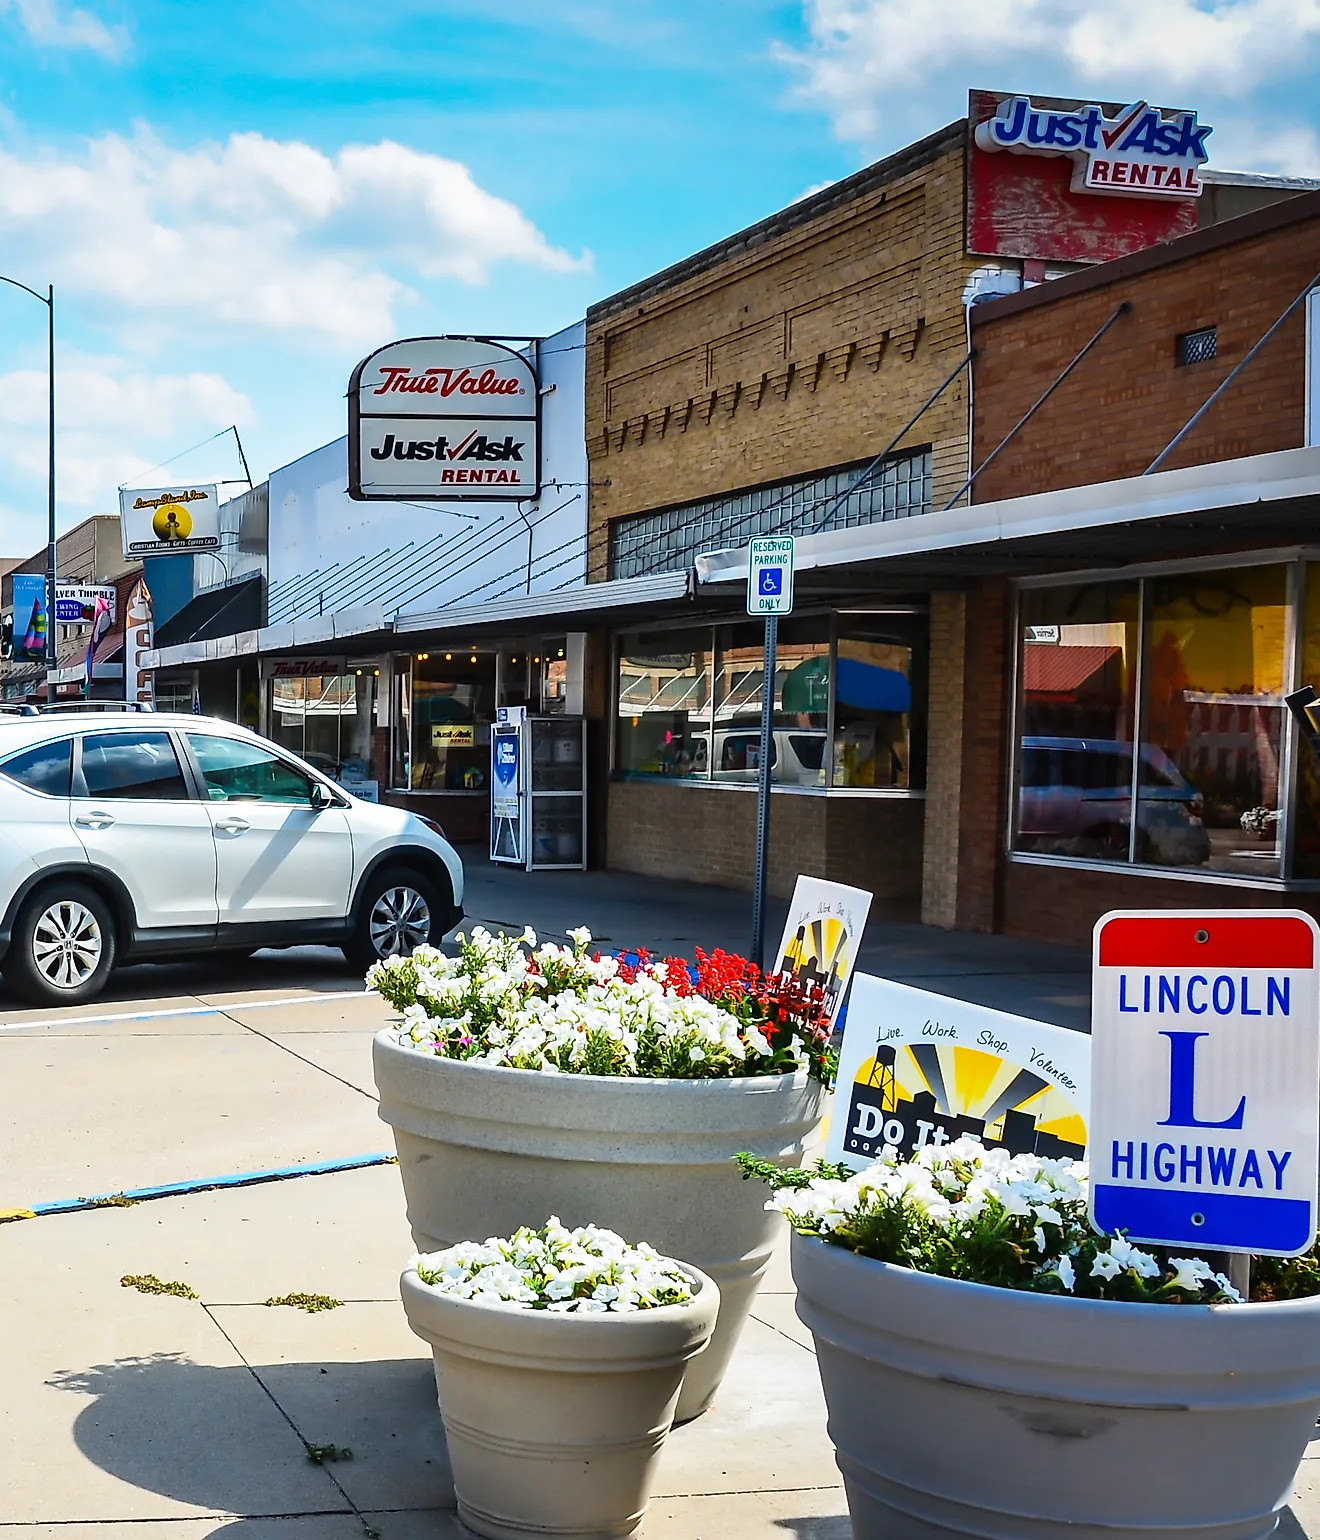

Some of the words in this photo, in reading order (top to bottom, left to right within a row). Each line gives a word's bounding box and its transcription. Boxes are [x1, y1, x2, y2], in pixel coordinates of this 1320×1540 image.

[995, 101, 1101, 148] Just
[1118, 113, 1212, 158] Ask
[1091, 160, 1199, 188] RENTAL
[370, 434, 449, 461] Just
[457, 435, 525, 461] Ask
[440, 469, 521, 483] RENTAL
[753, 540, 792, 552] RESERVED
[754, 554, 788, 565] PARKING
[759, 598, 781, 609] ONLY
[1118, 974, 1291, 1017] LINCOLN
[921, 1019, 959, 1040] Work.
[976, 1030, 1010, 1054] Shop.
[1030, 1046, 1078, 1095] Volunteer.
[1156, 1031, 1246, 1130] L
[852, 1102, 905, 1145] Do
[1111, 1139, 1292, 1191] HIGHWAY
